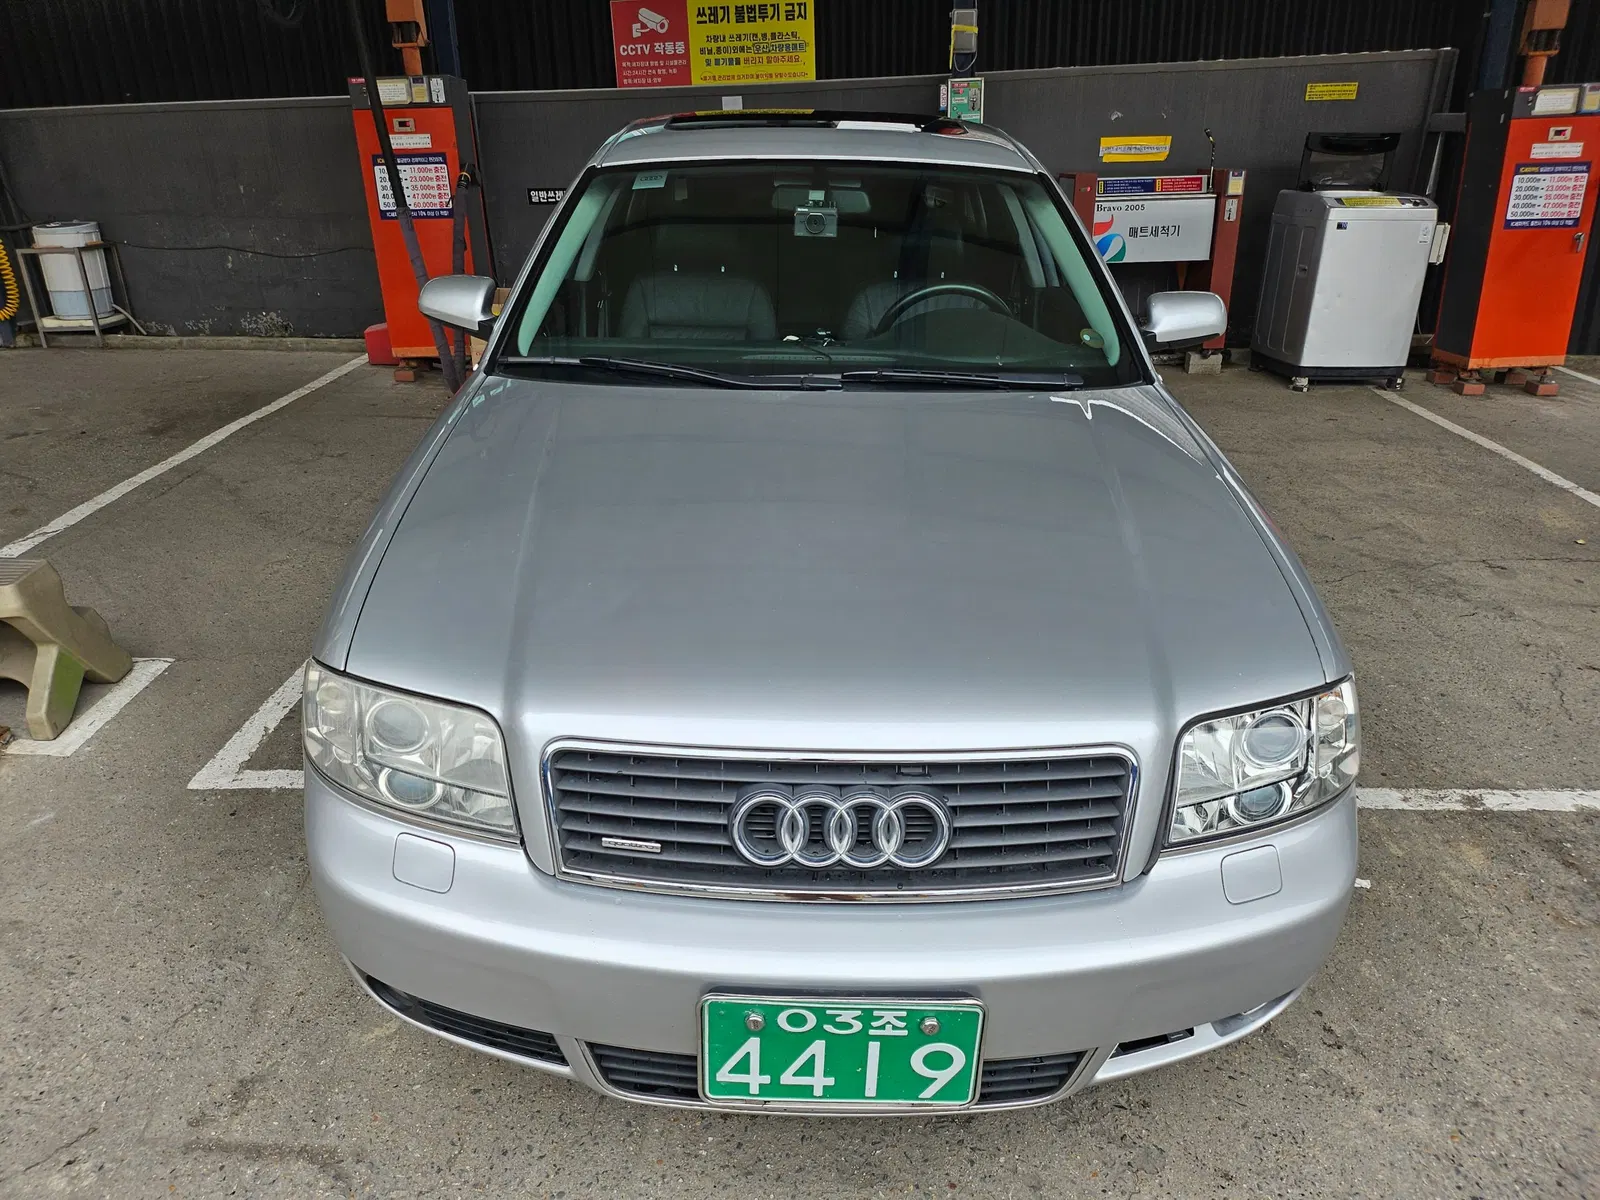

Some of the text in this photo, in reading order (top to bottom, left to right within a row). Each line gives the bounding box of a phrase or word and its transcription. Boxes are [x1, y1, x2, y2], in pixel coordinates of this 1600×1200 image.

[696, 2, 807, 25] 쓰레기 불법투기 금지
[705, 34, 726, 43] 차량내
[620, 41, 685, 56] CCTV 작동중
[705, 58, 712, 67] 및
[743, 56, 764, 66] 버리지
[531, 190, 566, 202] 일반쓰레
[1096, 203, 1146, 212] Bravo 2005
[1128, 225, 1181, 239] 매트세척기
[777, 1008, 908, 1037] 03조
[715, 1036, 967, 1099] 4419
